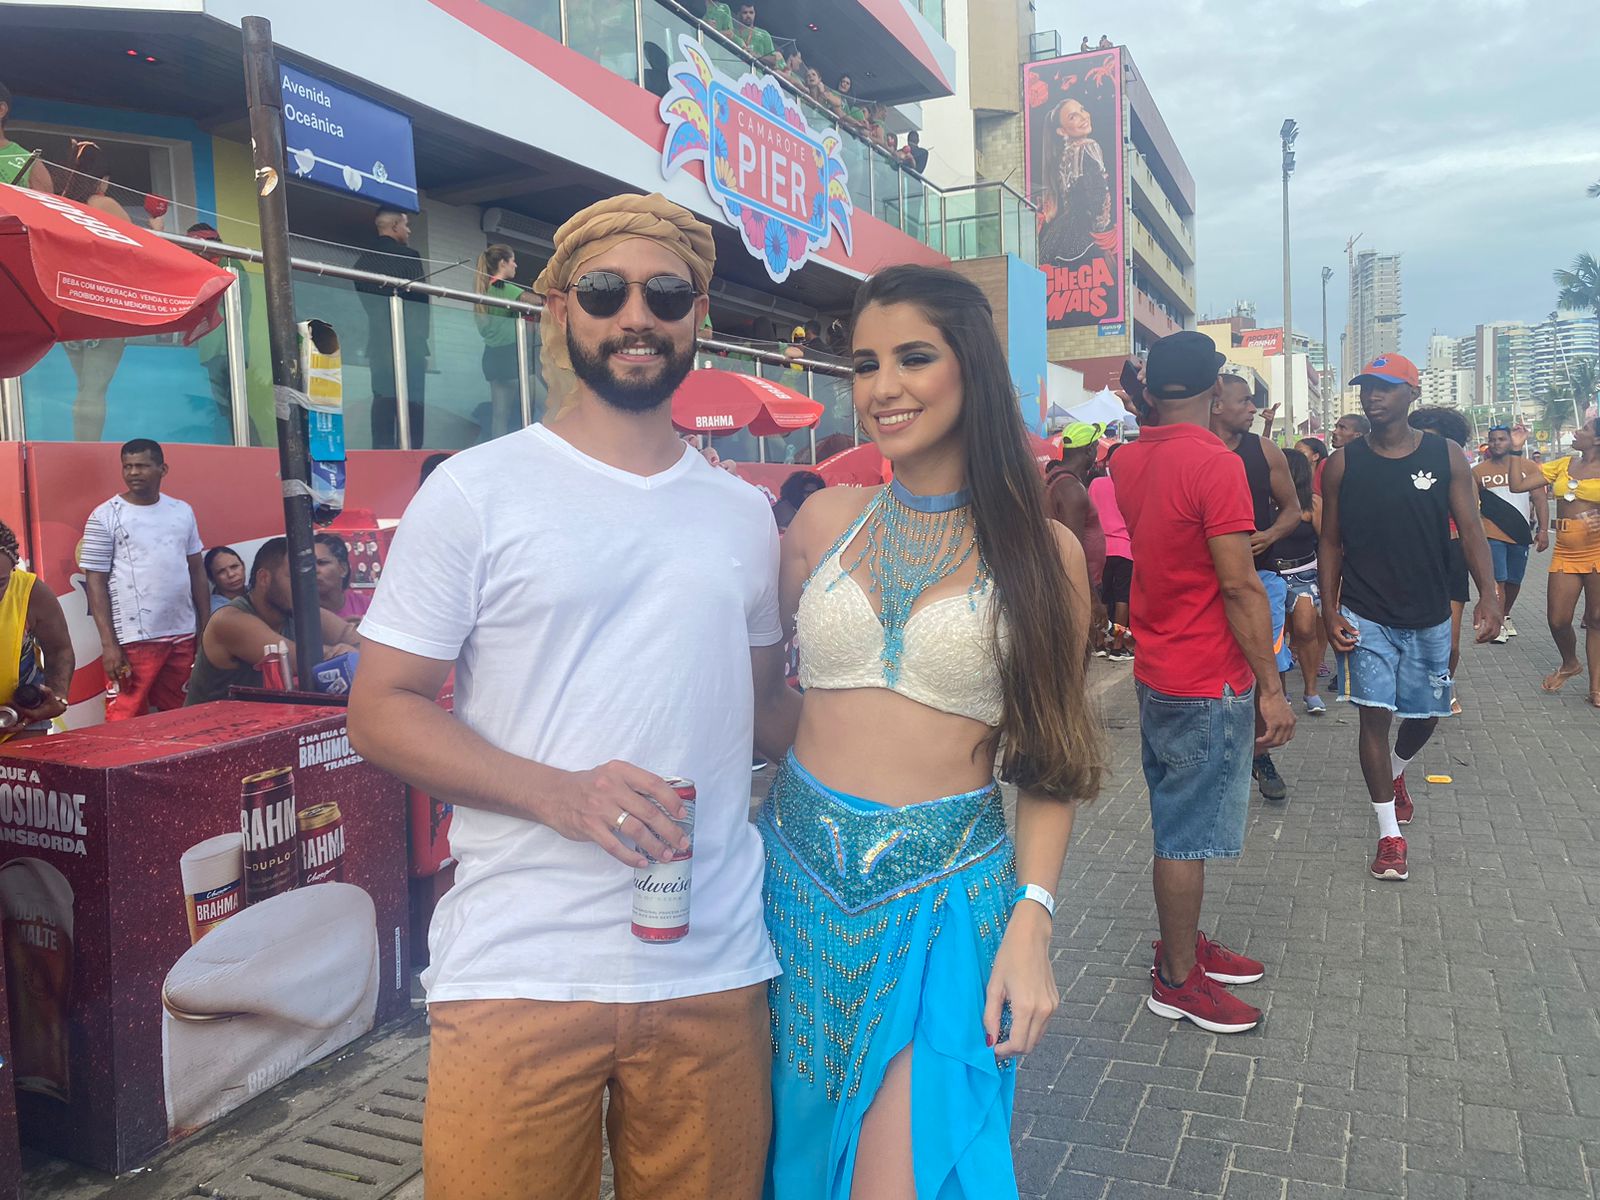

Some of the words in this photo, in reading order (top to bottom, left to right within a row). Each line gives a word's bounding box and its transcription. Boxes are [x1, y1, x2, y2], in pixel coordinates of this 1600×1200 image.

[282, 75, 331, 108] Avenida
[284, 103, 344, 138] Oceânica
[737, 111, 806, 161] CAMAROTE
[738, 132, 808, 219] PIER
[62, 277, 79, 287] BEBA
[80, 281, 96, 290] COM
[695, 415, 734, 428] BRAHMA
[306, 734, 320, 744] NA
[320, 729, 339, 740] RUA
[0, 765, 27, 782] QUE
[29, 769, 41, 784] A
[252, 851, 291, 872] DUPLO
[196, 893, 240, 921] BRAHMA
